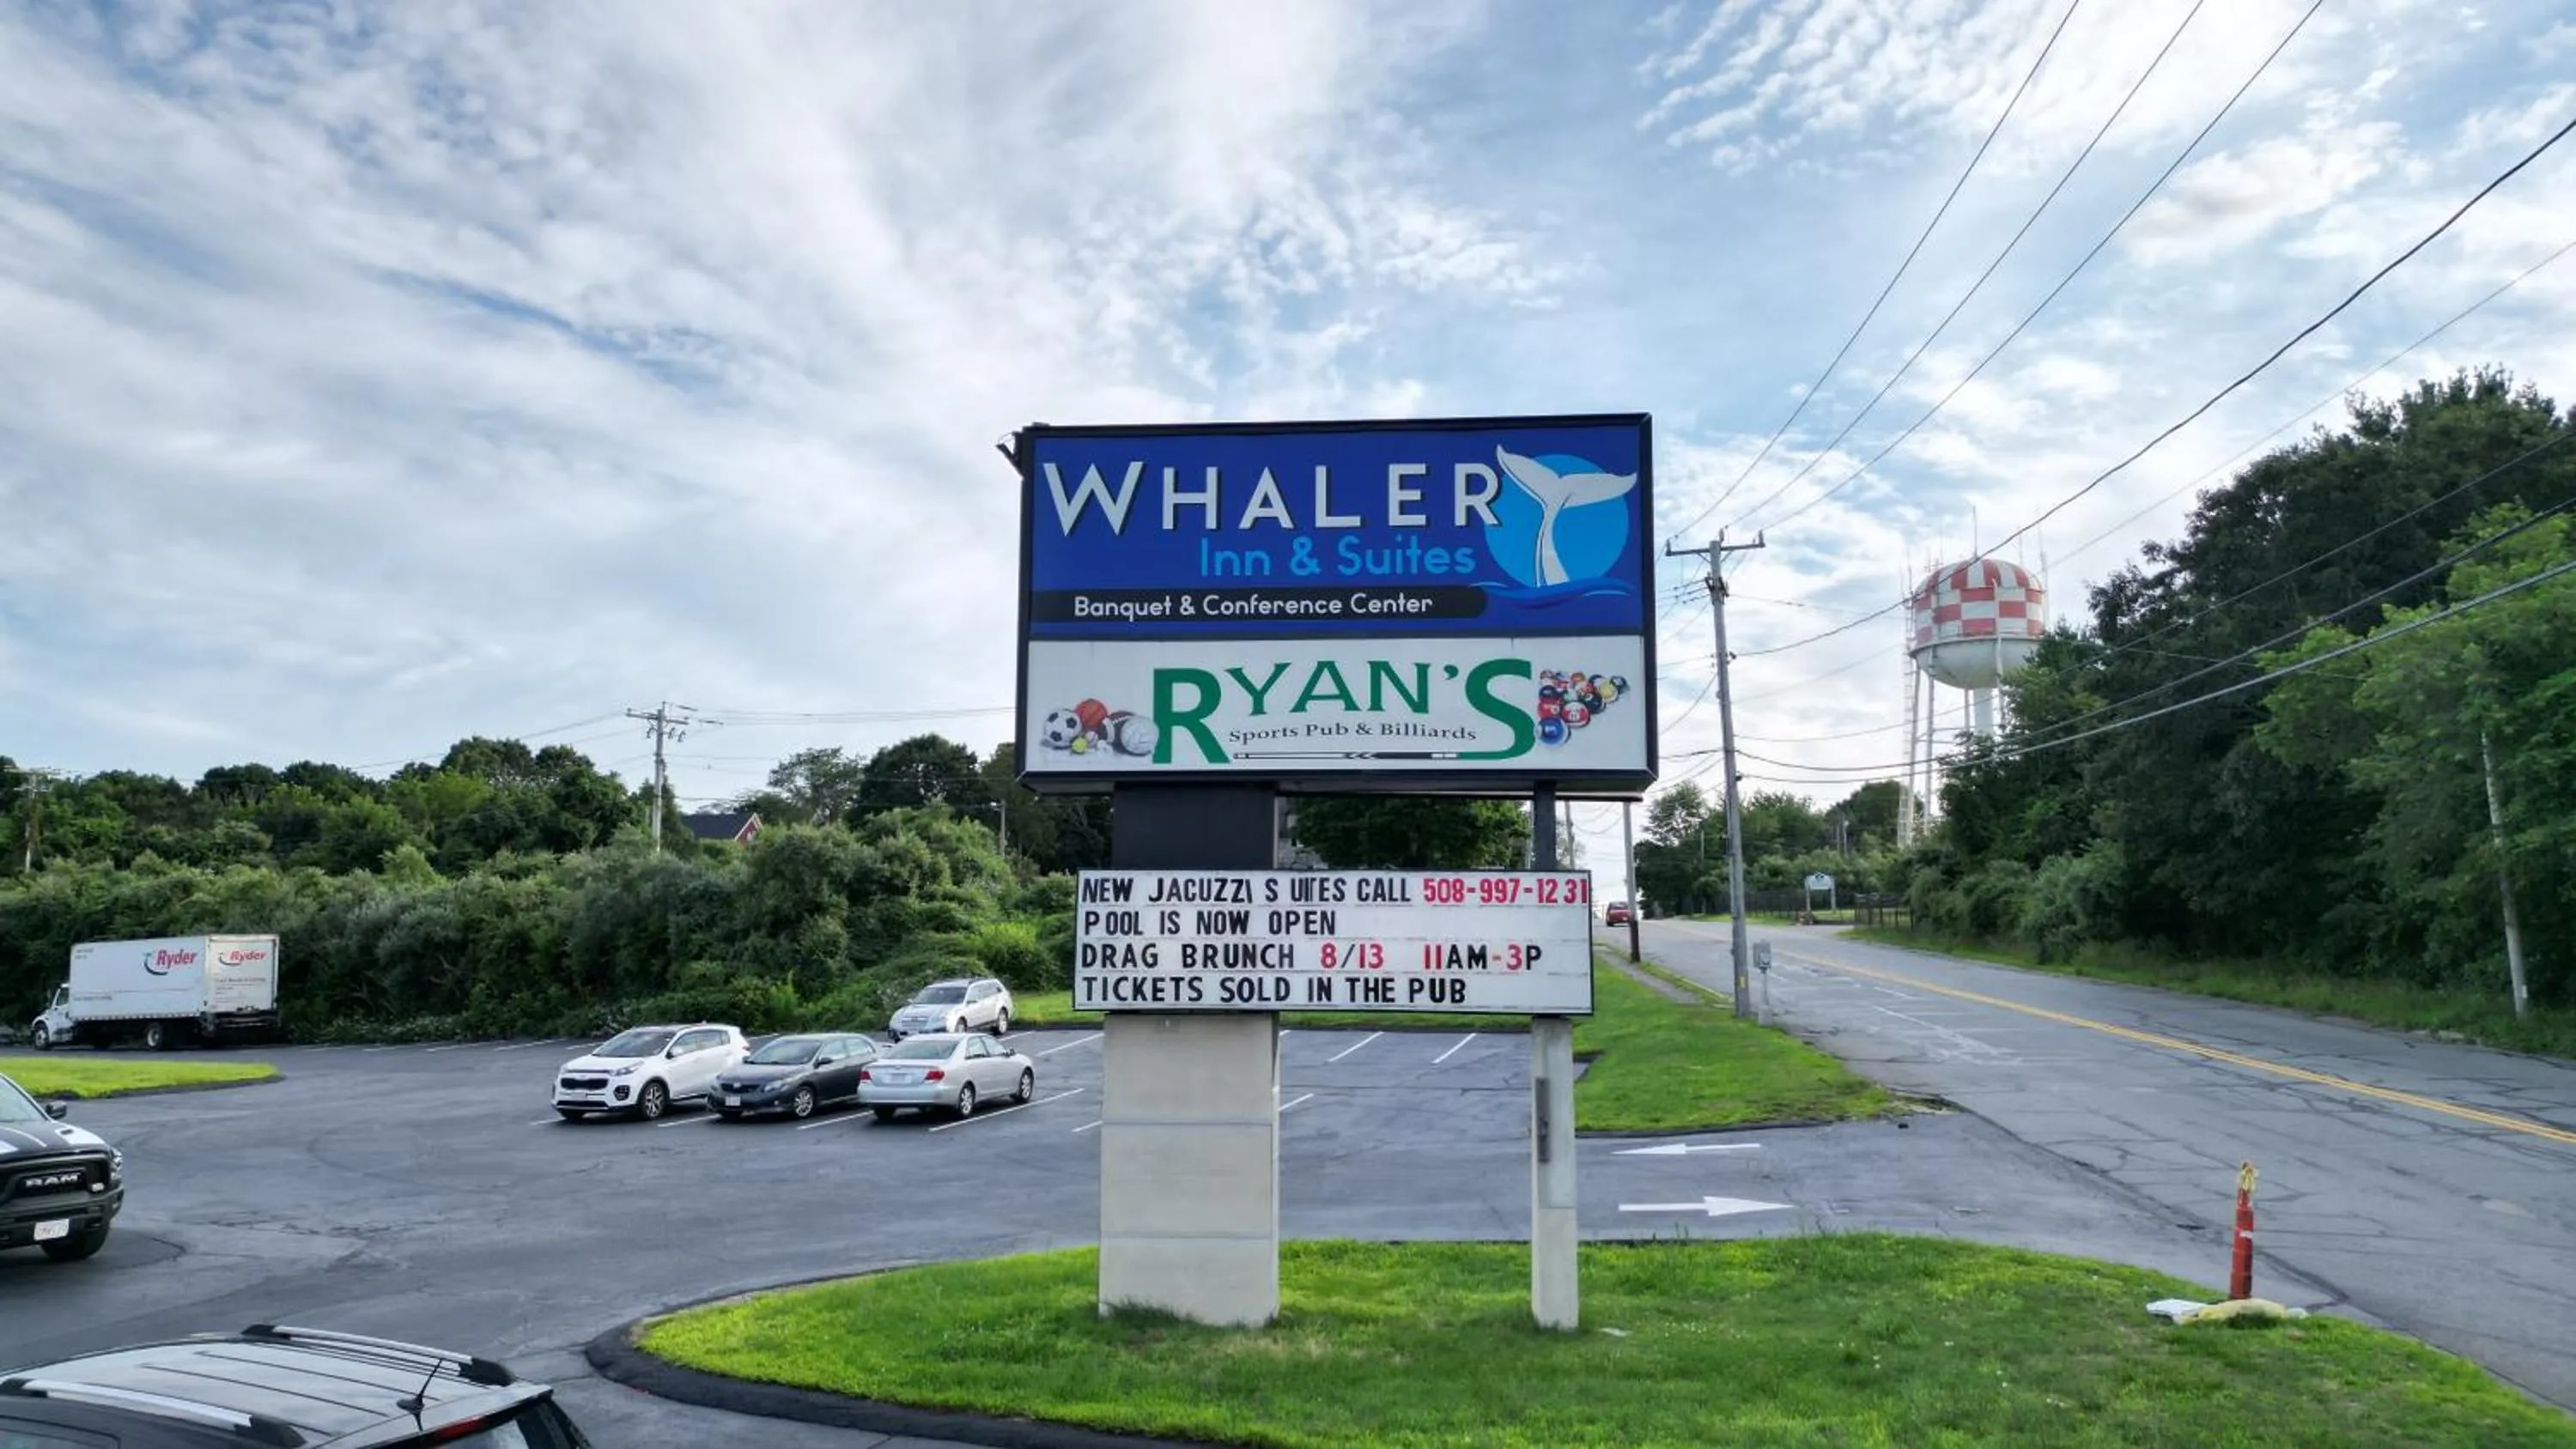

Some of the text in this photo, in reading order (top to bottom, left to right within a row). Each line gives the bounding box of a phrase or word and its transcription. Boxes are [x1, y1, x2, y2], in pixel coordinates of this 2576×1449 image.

[1042, 460, 1501, 538] WHALER
[1201, 534, 1476, 577] Inn & Suites
[1073, 591, 1434, 623] Banquet & Conference Center
[1151, 658, 1534, 765] RYAN'S
[1229, 721, 1477, 746] Sports Pub & Billiards
[1082, 878, 1133, 902] NEW
[1149, 877, 1253, 903] JACUZZI
[1358, 878, 1411, 902] CALL
[1084, 910, 1335, 936] POOL IS NOW OPEN
[155, 949, 197, 969] Ryder
[229, 950, 267, 961] Ryder
[1081, 943, 1158, 969] DRAG
[1182, 944, 1294, 969] BRUNCH
[1321, 943, 1384, 969] 8/13
[1083, 976, 1467, 1004] TICKETS SOLD IN THE PUB
[26, 1174, 79, 1187] RAM
